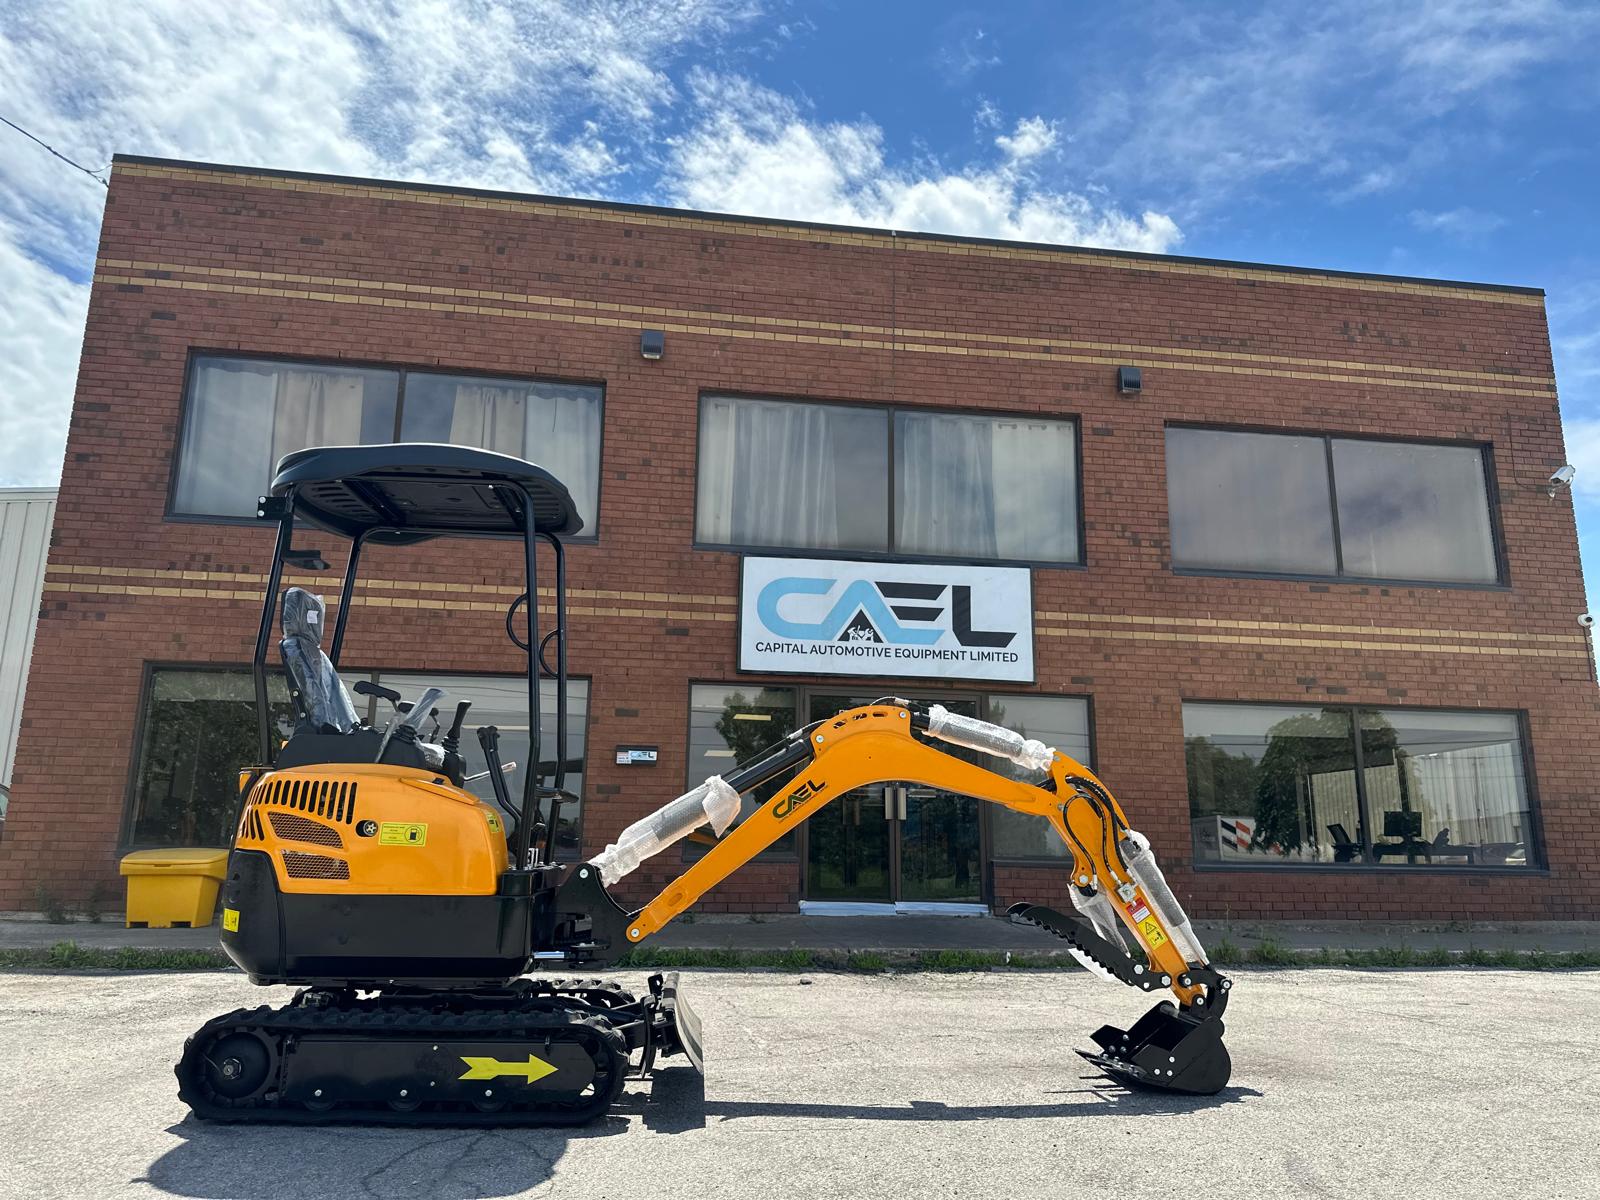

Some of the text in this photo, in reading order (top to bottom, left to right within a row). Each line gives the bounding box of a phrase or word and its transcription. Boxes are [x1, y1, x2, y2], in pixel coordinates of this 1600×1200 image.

[757, 576, 1017, 648] CAEL
[755, 641, 1019, 663] CAPITAL AUTOMOTIVE EQUIPMENT LIMITED
[772, 779, 826, 819] CAEL
